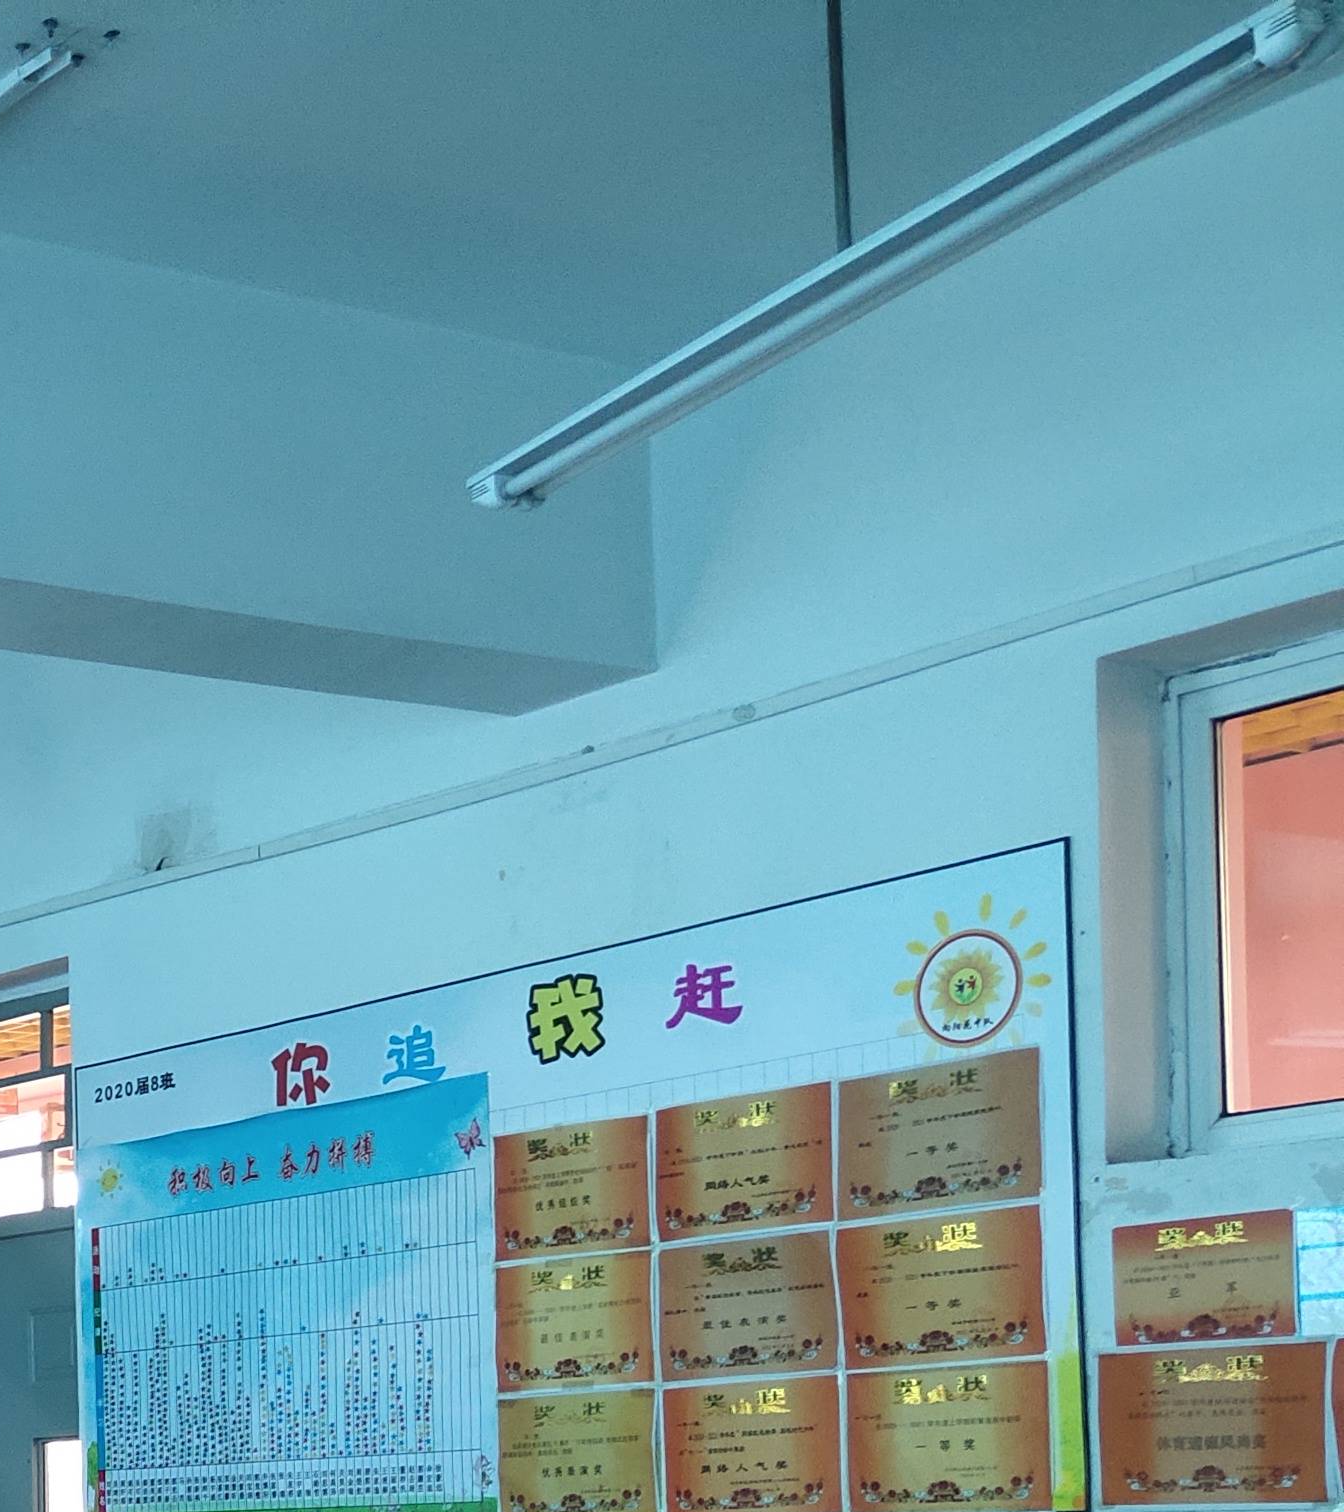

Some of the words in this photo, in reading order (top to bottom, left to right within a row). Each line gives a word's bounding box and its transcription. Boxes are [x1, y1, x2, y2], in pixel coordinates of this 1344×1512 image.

[95, 1073, 176, 1103] 2020届8班
[168, 1156, 260, 1198] 积极向上
[278, 1130, 376, 1180] 奋力拼搏
